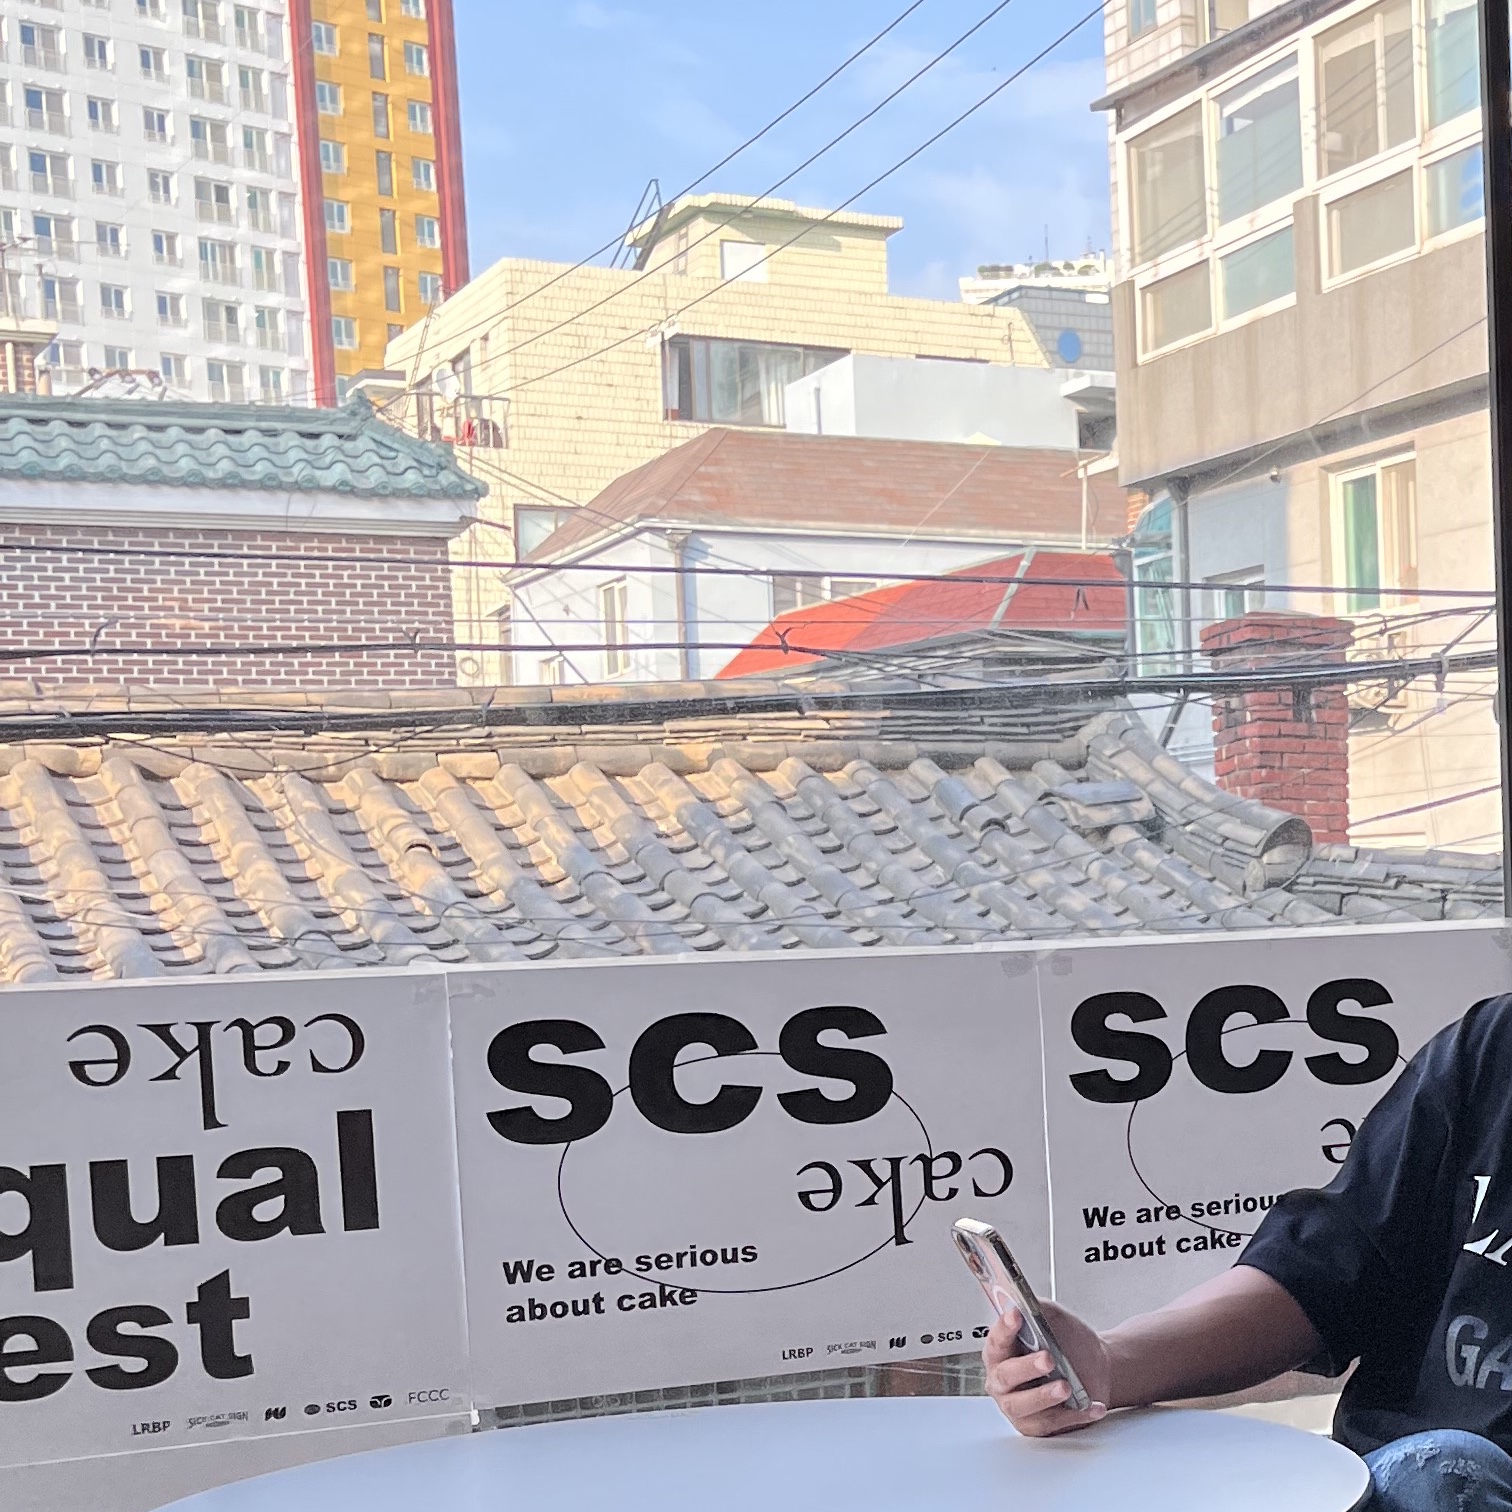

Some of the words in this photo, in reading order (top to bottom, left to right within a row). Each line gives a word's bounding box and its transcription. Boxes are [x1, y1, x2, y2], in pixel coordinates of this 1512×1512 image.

[1069, 978, 1399, 1103] SCS
[67, 1013, 364, 1130] cake
[486, 1006, 893, 1144] SCS
[797, 1147, 1014, 1246] cake
[1083, 1206, 1127, 1228] We
[1136, 1205, 1181, 1222] are
[503, 1260, 555, 1284] We
[568, 1257, 622, 1278] are
[635, 1243, 758, 1272] serious
[1084, 1233, 1166, 1264] about
[1176, 1226, 1242, 1254] cake
[506, 1293, 606, 1324] about
[617, 1283, 698, 1310] cake
[782, 1347, 814, 1360] LRBP
[937, 1331, 963, 1342] SCS
[132, 1421, 170, 1435] LRBP
[326, 1400, 357, 1413] SCS
[408, 1388, 450, 1403] FCCC
